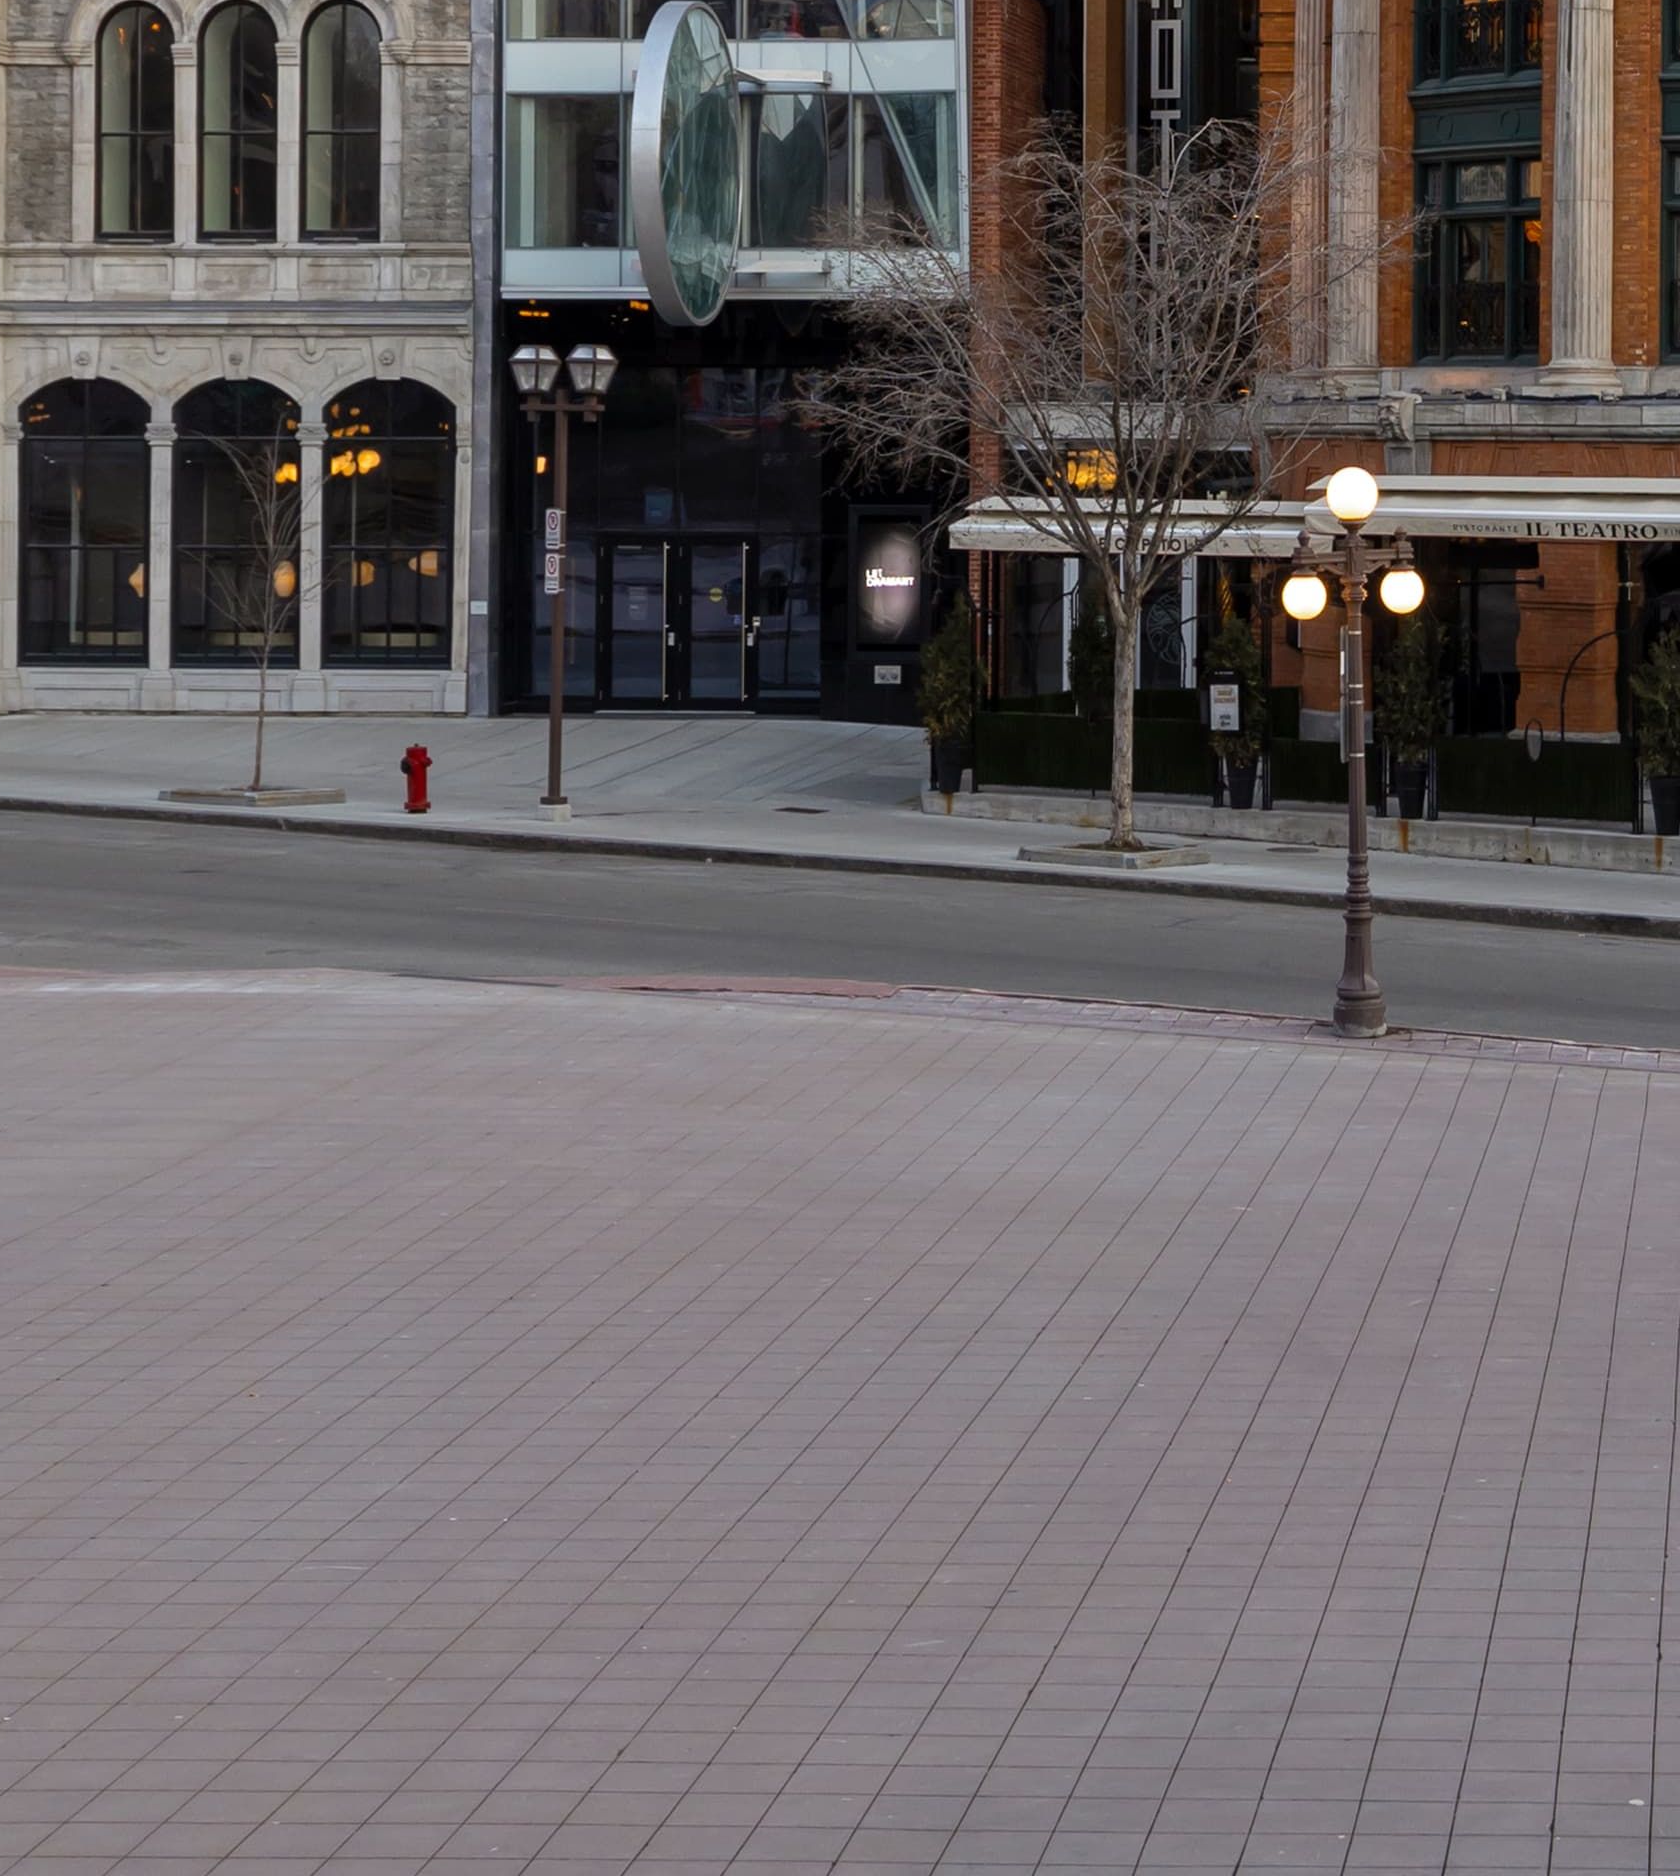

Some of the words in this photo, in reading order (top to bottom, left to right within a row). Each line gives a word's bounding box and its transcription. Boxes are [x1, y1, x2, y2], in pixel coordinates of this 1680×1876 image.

[1452, 523, 1519, 534] RISTORANTE
[1526, 521, 1550, 537] IL
[1555, 522, 1659, 540] TEATRO
